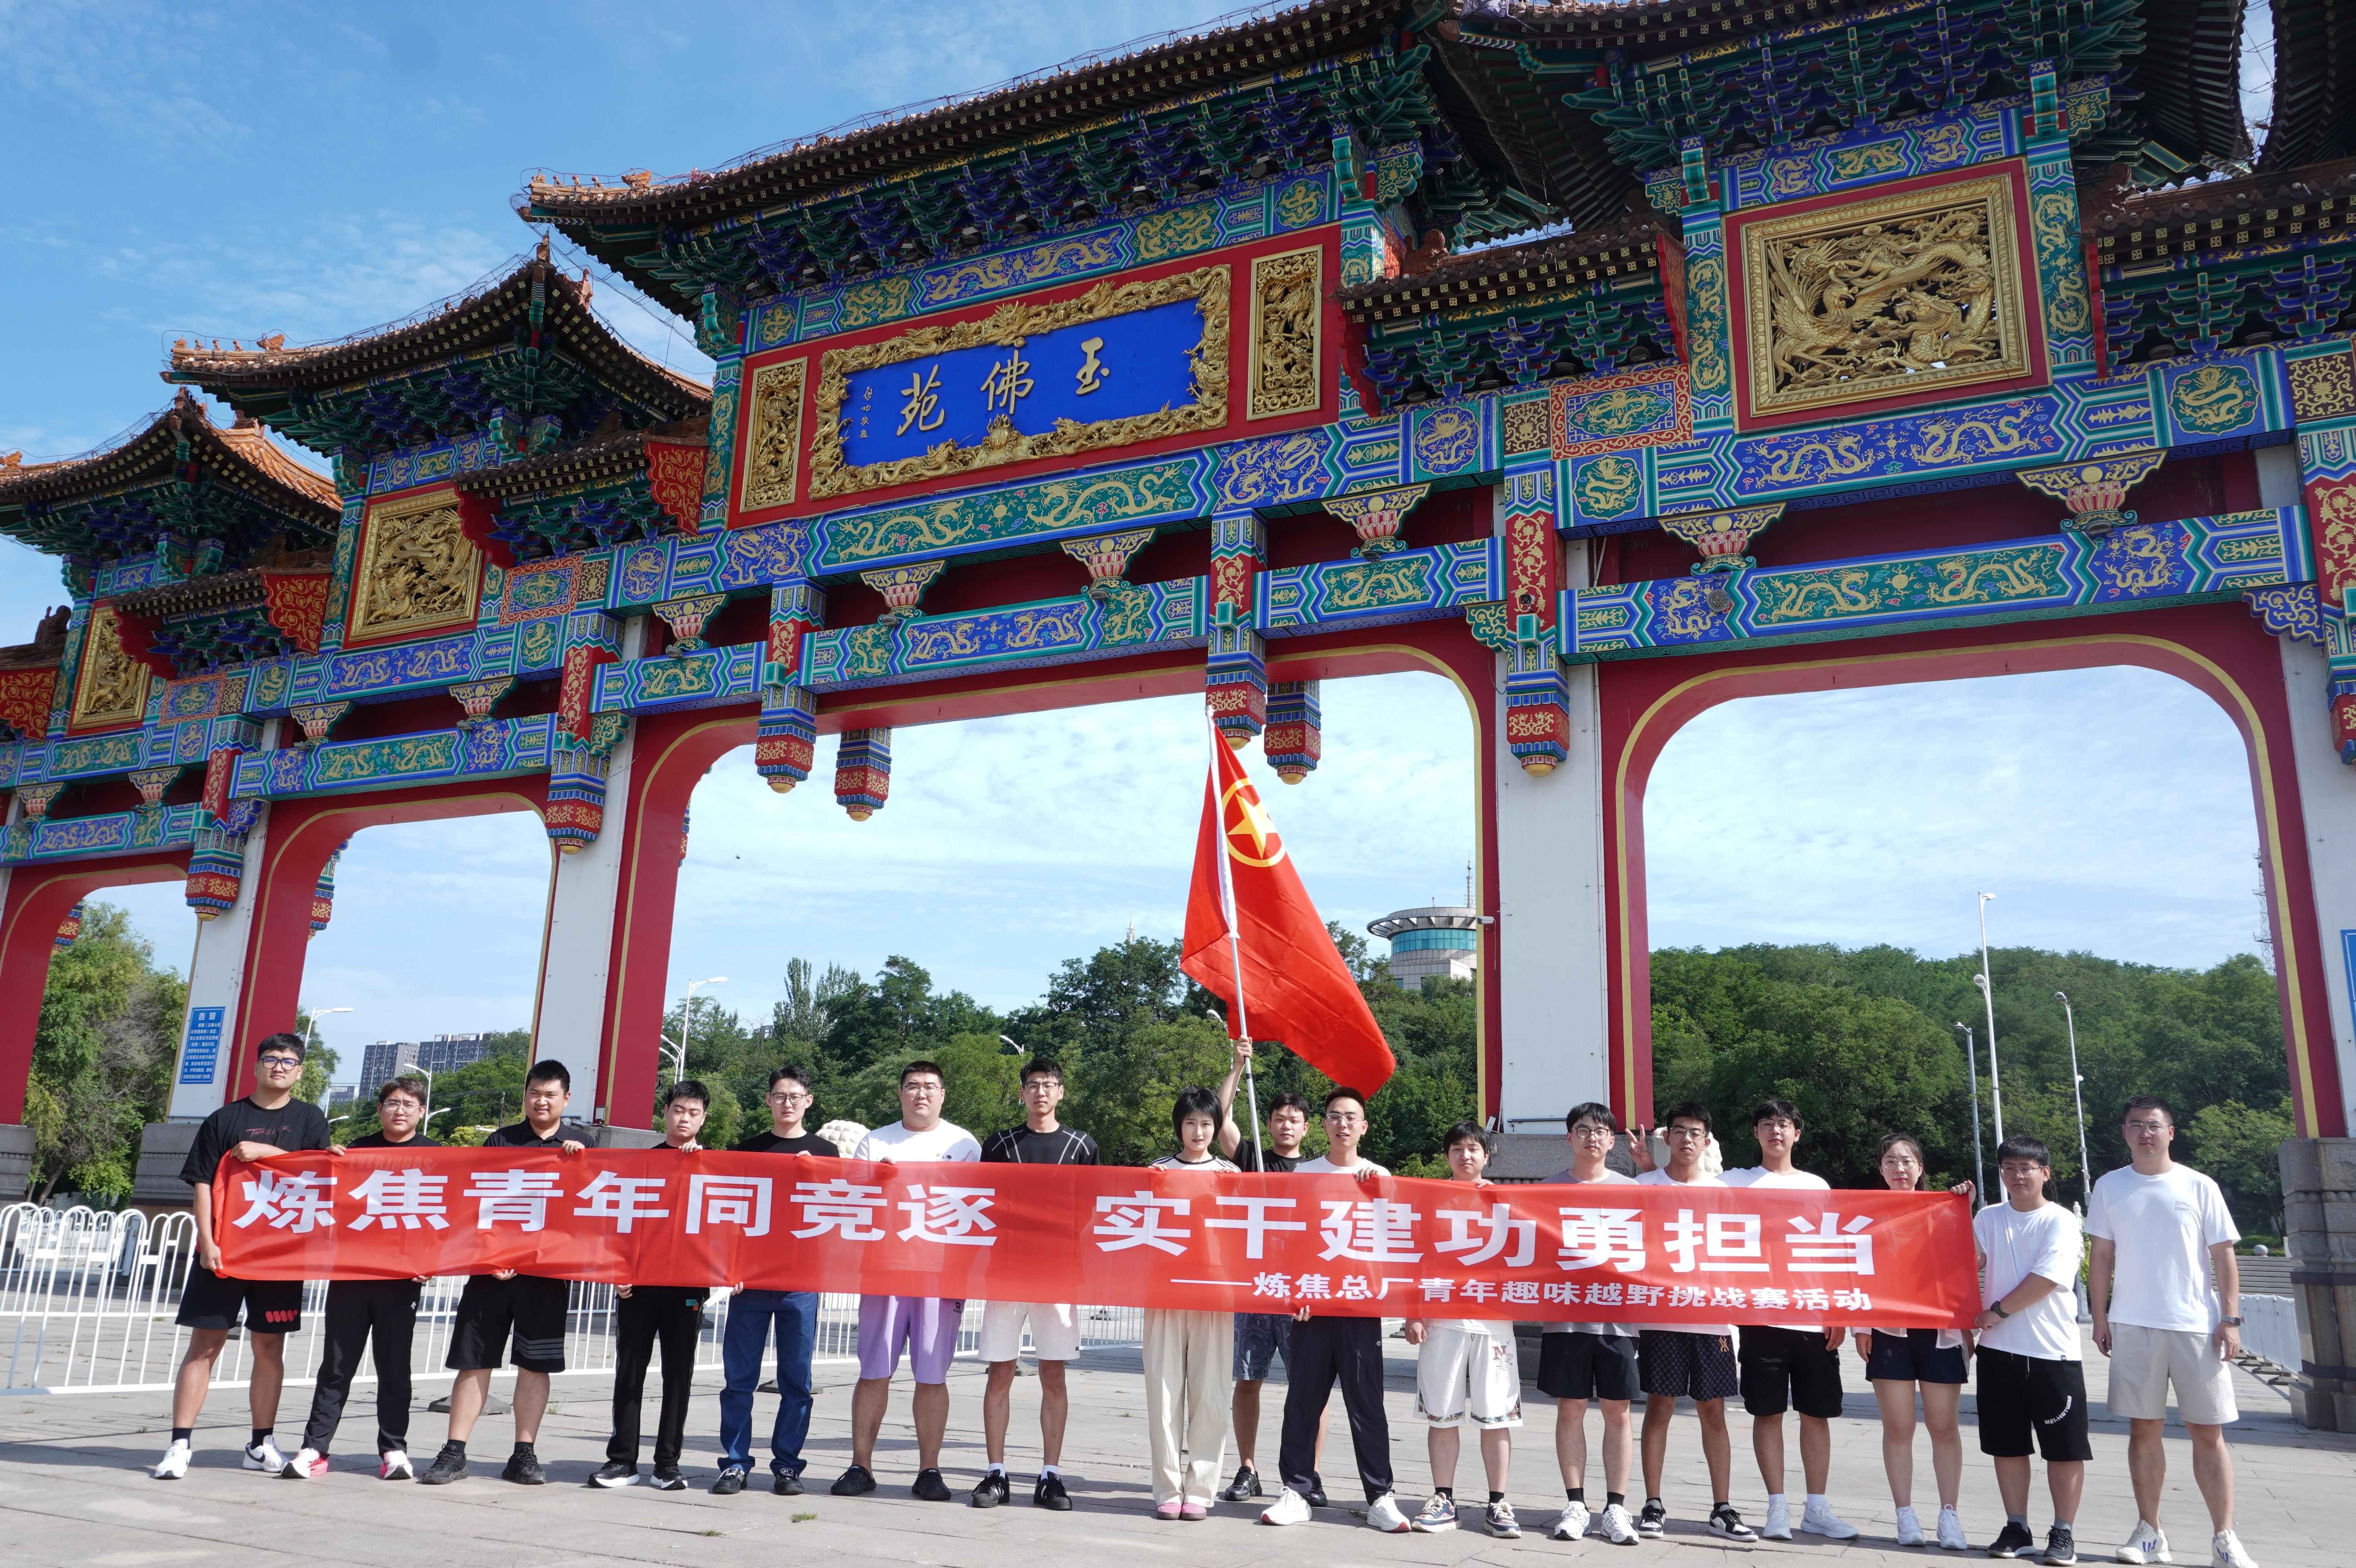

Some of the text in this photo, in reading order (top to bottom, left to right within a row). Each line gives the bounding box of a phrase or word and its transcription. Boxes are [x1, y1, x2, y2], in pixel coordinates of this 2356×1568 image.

[896, 336, 1111, 437] 玉佛苑
[245, 1125, 291, 1138] THRILLER
[232, 1168, 1874, 1275] 炼焦青年同竞逐 实干建功勇担当
